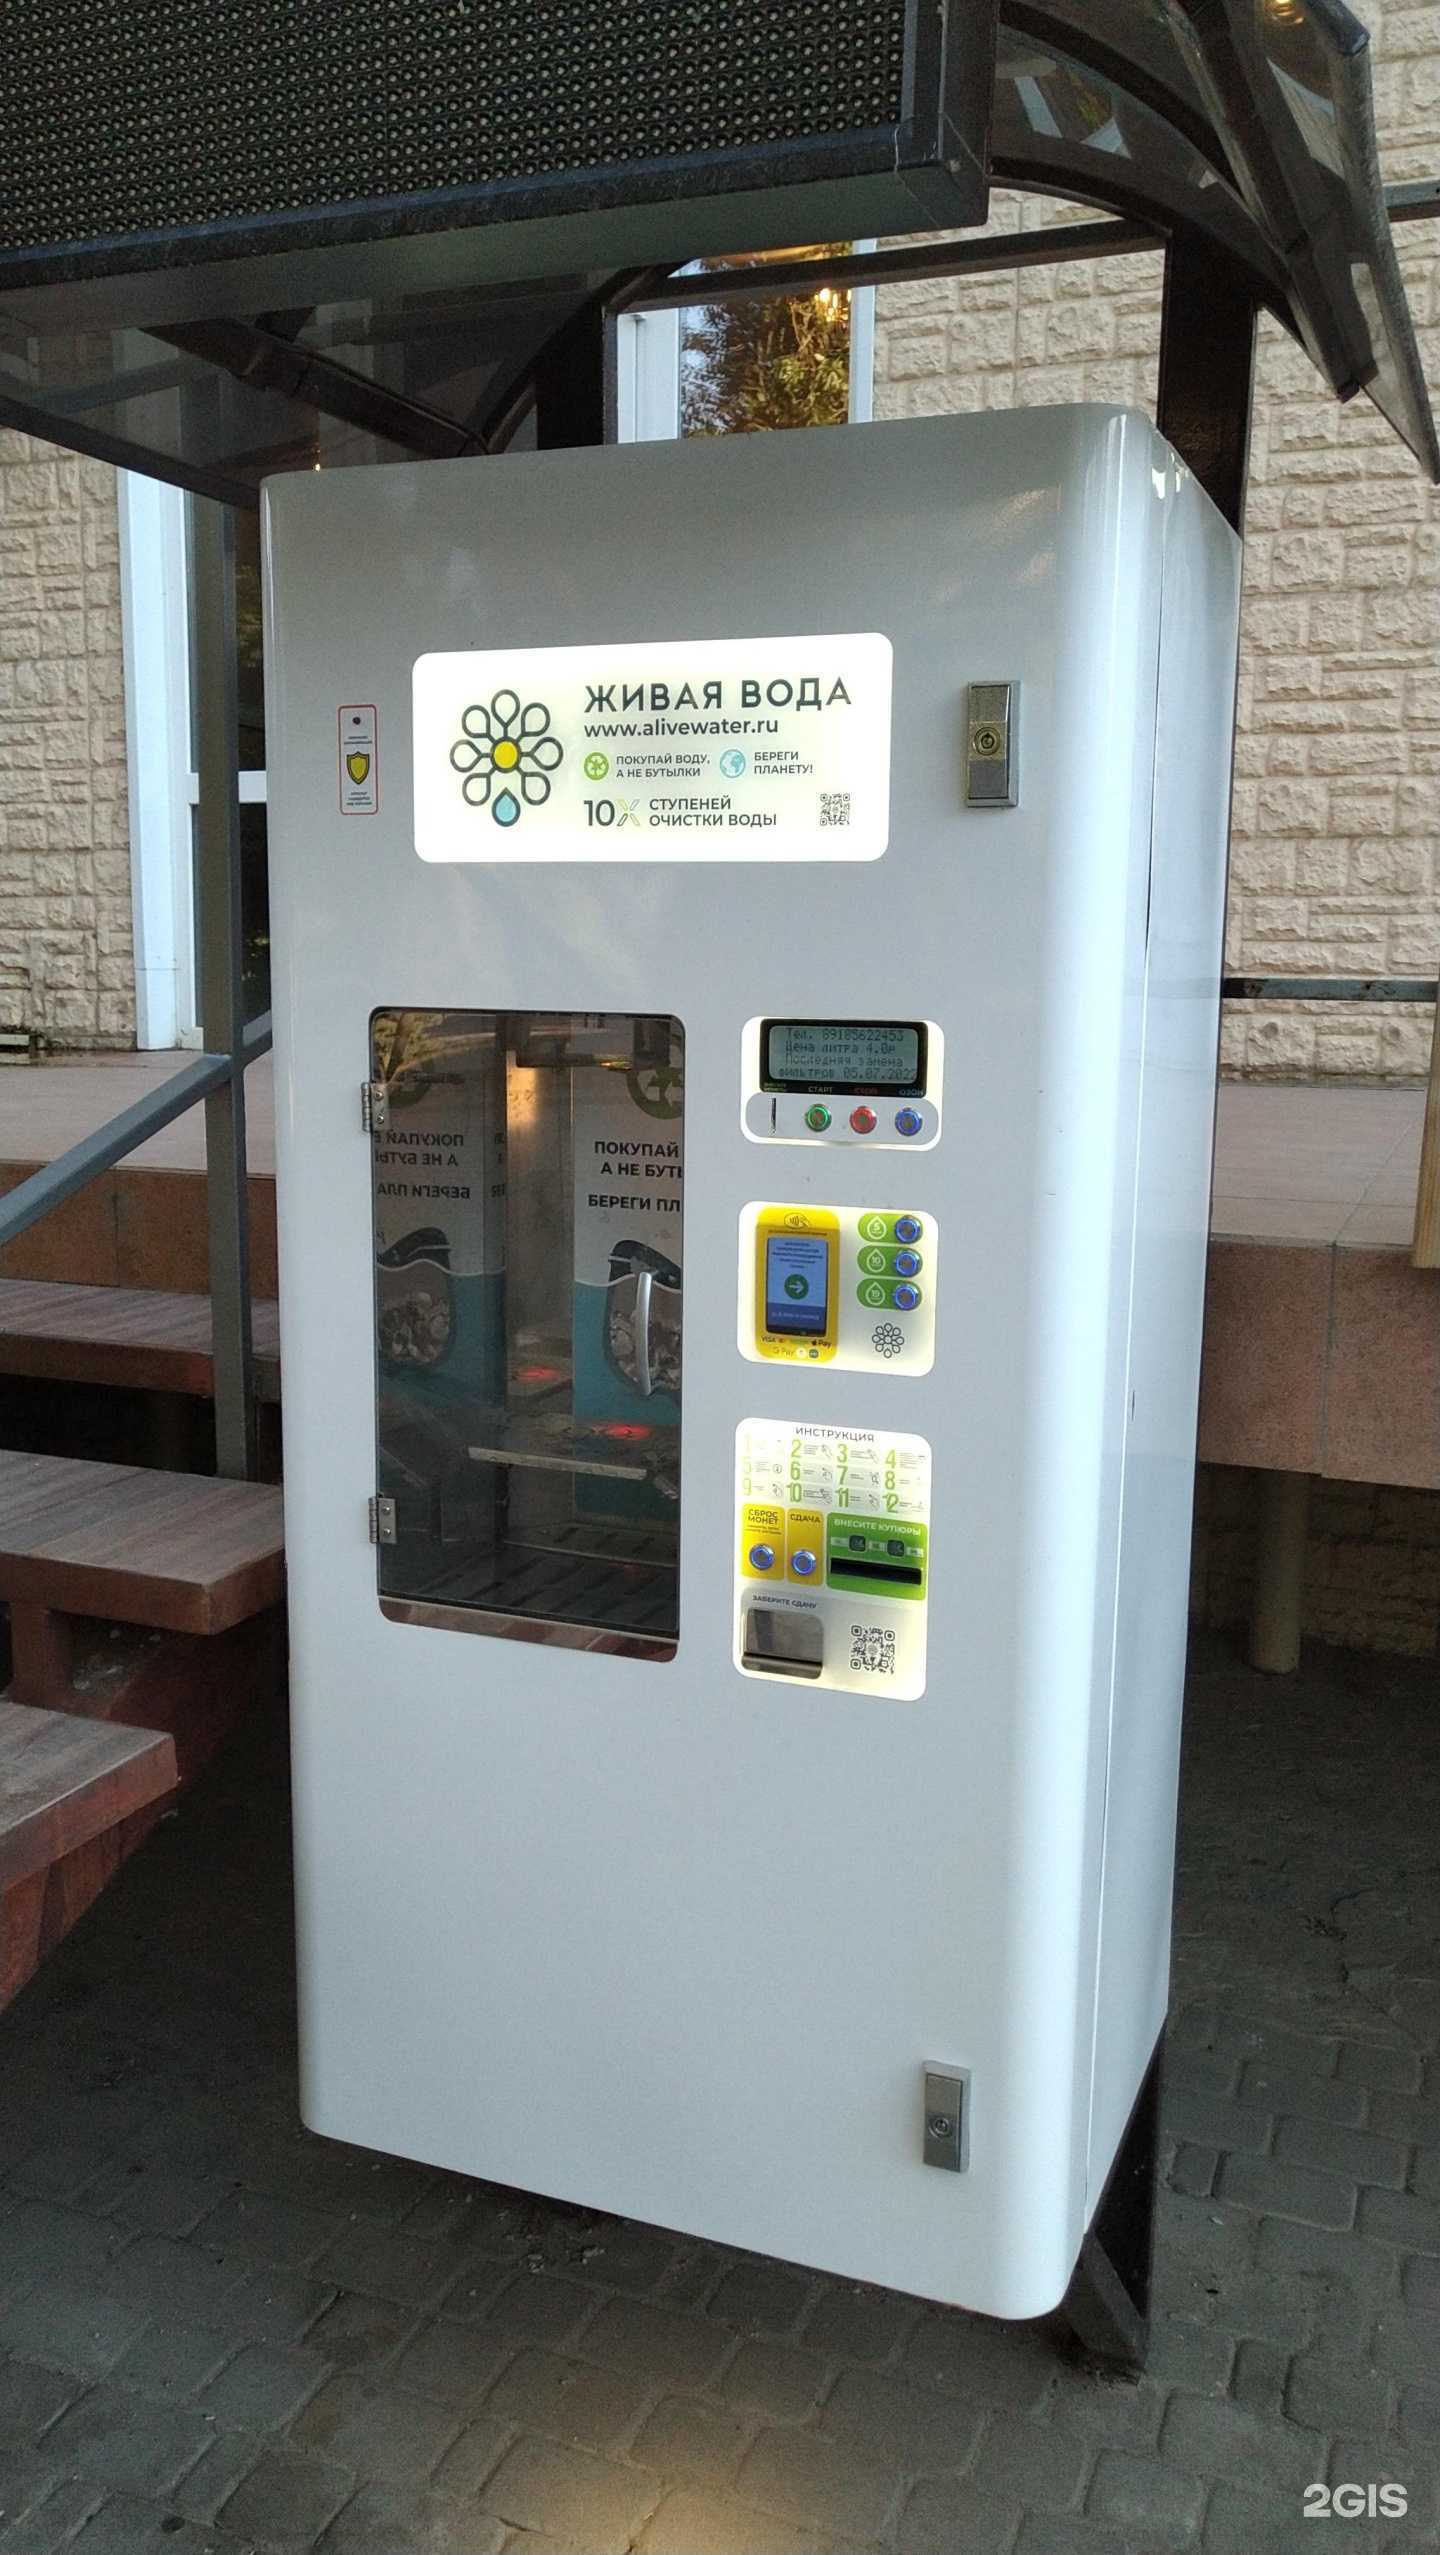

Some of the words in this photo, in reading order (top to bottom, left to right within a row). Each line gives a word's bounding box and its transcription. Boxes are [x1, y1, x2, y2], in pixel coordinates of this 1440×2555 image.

[584, 680, 722, 713] ЖИВАЯ
[741, 676, 852, 711] ВОДА
[584, 718, 778, 737] www.alivewater.ru
[616, 753, 672, 765] ПОКУПАЙ
[675, 754, 710, 764] ВОДУ,
[754, 751, 799, 761] БЕРЕГИ
[616, 769, 624, 778] А
[627, 768, 642, 778] НЕ
[645, 767, 701, 778] БУТЫЛКИ
[754, 764, 813, 774] ПЛАНЕТУ!
[649, 795, 731, 810] СТУПЕНЕЙ
[649, 814, 723, 826] ОЧИСТКИ
[728, 814, 777, 827] ВОДЫ
[785, 1040, 815, 1053] Цена
[785, 1053, 851, 1065] Последняя
[858, 1057, 903, 1068] замена
[808, 1086, 833, 1094] СТАРТ
[594, 1141, 680, 1158] ПОКУПАЙ
[600, 1161, 613, 1175] А
[618, 1163, 640, 1176] НЕ
[588, 1194, 651, 1211] БЕРЕГИ
[796, 1427, 875, 1443] ИНСТРУКЦИЯ
[791, 1439, 802, 1459] 2
[837, 1443, 848, 1463] 3
[884, 1448, 897, 1469] 4
[790, 1461, 801, 1481] 6
[837, 1465, 849, 1485] 7
[884, 1470, 896, 1490] 8
[786, 1482, 802, 1503] 10
[834, 1488, 849, 1508] 11
[882, 1493, 899, 1513] 12
[748, 1509, 778, 1518] СБРОС
[748, 1515, 778, 1525] МОНЕТ
[790, 1513, 821, 1523] СДАЧА
[833, 1518, 877, 1530] ВНЕСИТЕ
